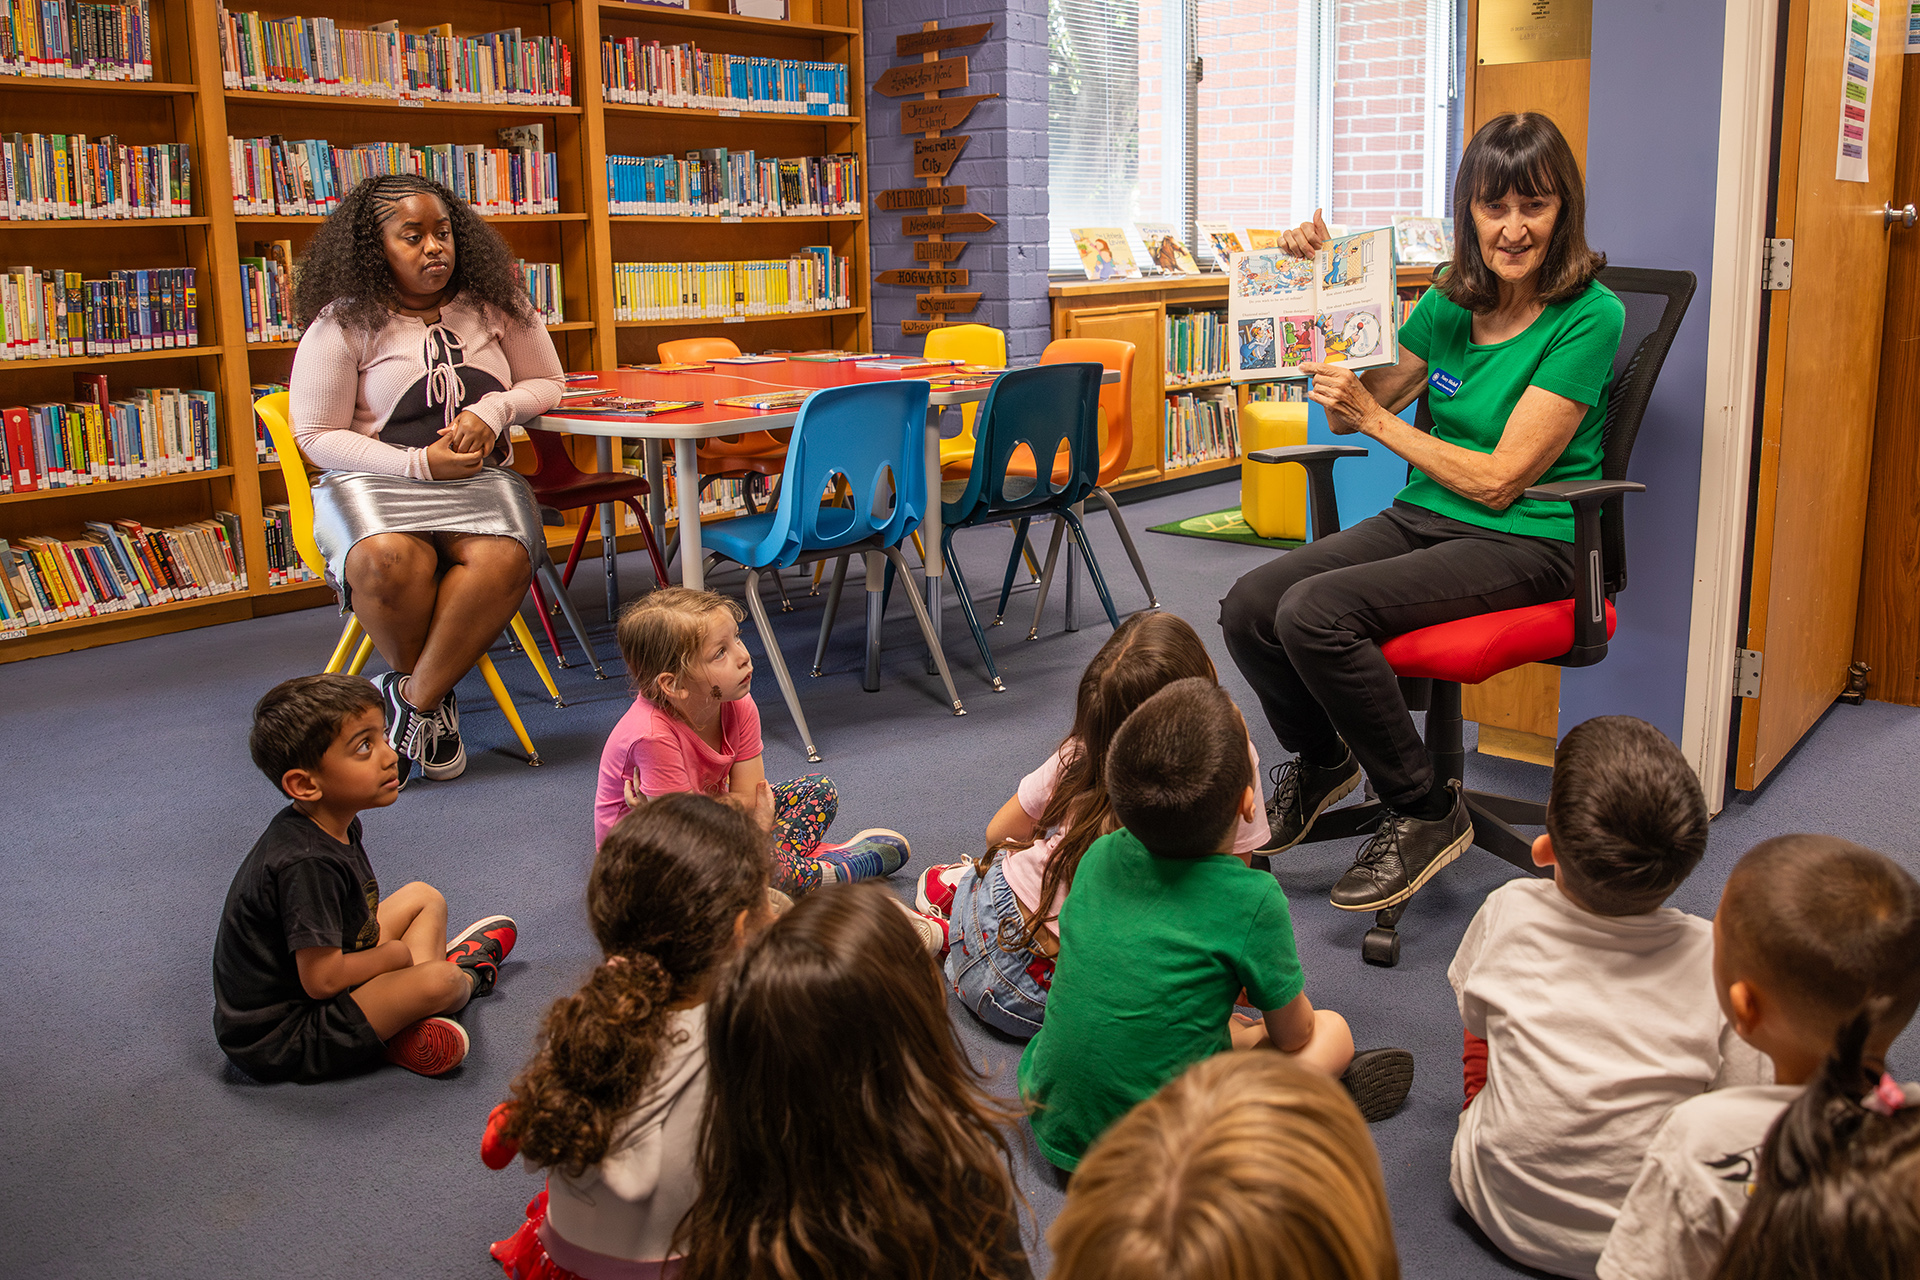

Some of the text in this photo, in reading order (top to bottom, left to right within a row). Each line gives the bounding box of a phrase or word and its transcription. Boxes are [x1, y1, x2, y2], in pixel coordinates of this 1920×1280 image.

[907, 104, 944, 118] Treasure
[917, 114, 947, 128] Island
[915, 139, 957, 154] Emerald
[922, 158, 941, 174] City
[886, 188, 950, 208] METROPOLIS
[909, 217, 946, 233] Neverland
[1103, 231, 1123, 239] Littlest
[917, 243, 951, 260] GOTHAM
[897, 271, 957, 284] HOGWARTS
[135, 530, 147, 547] LUPICA
[158, 535, 168, 551] LUPICA
[153, 547, 164, 562] LUPICA
[163, 566, 172, 580] HEAT
[52, 571, 70, 602] RULES
